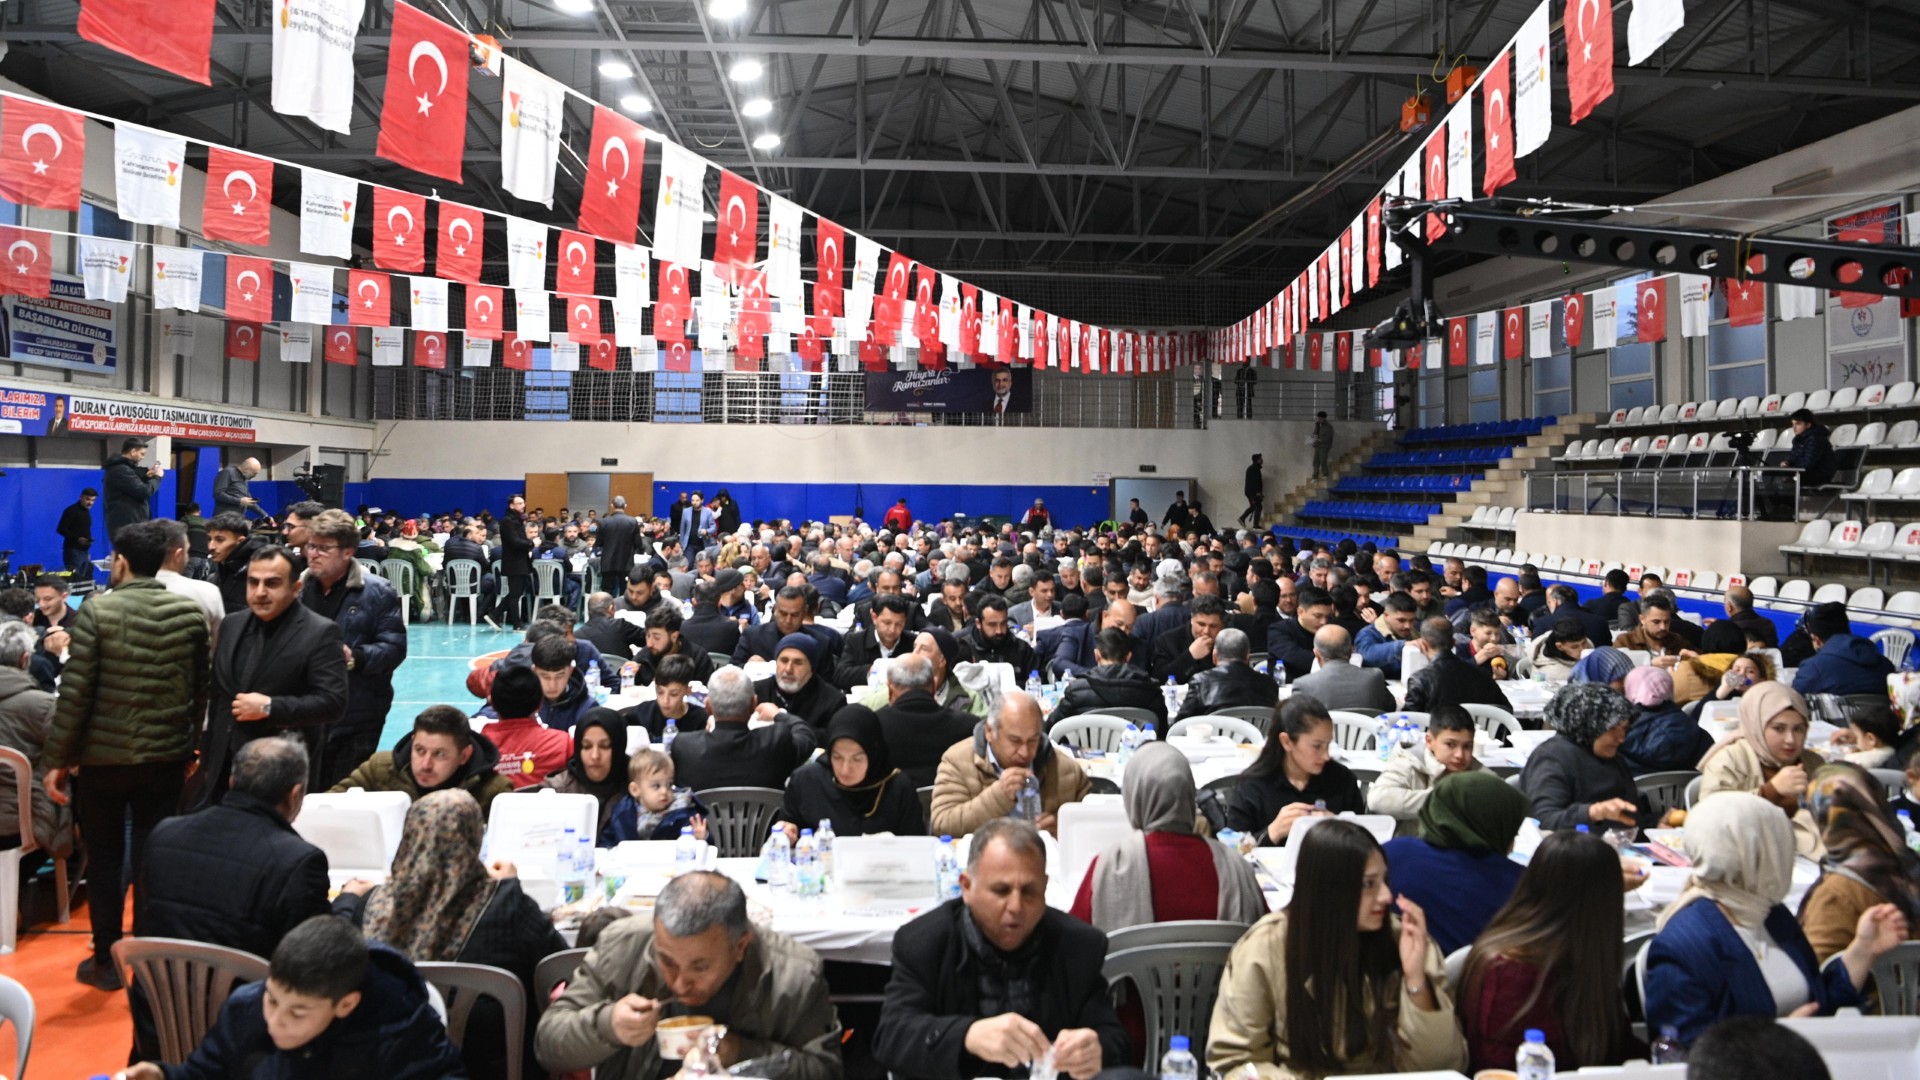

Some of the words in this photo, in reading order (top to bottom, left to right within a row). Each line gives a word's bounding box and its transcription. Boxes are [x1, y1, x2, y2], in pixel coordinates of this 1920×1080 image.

[49, 299, 59, 309] VE
[60, 301, 110, 319] ANTRENÖRLERE
[18, 308, 70, 331] BAŞARILAR
[891, 371, 951, 392] Ramazanlar
[0, 389, 46, 406] LARIMIZA
[74, 400, 106, 415] DURAN
[109, 403, 160, 422] ÇAVUŞOĞLU
[161, 408, 209, 427] TAŞIMACILIK
[210, 414, 218, 425] VE
[220, 415, 253, 429] OTOMOTİV
[138, 424, 171, 436] BAŞARILAR
